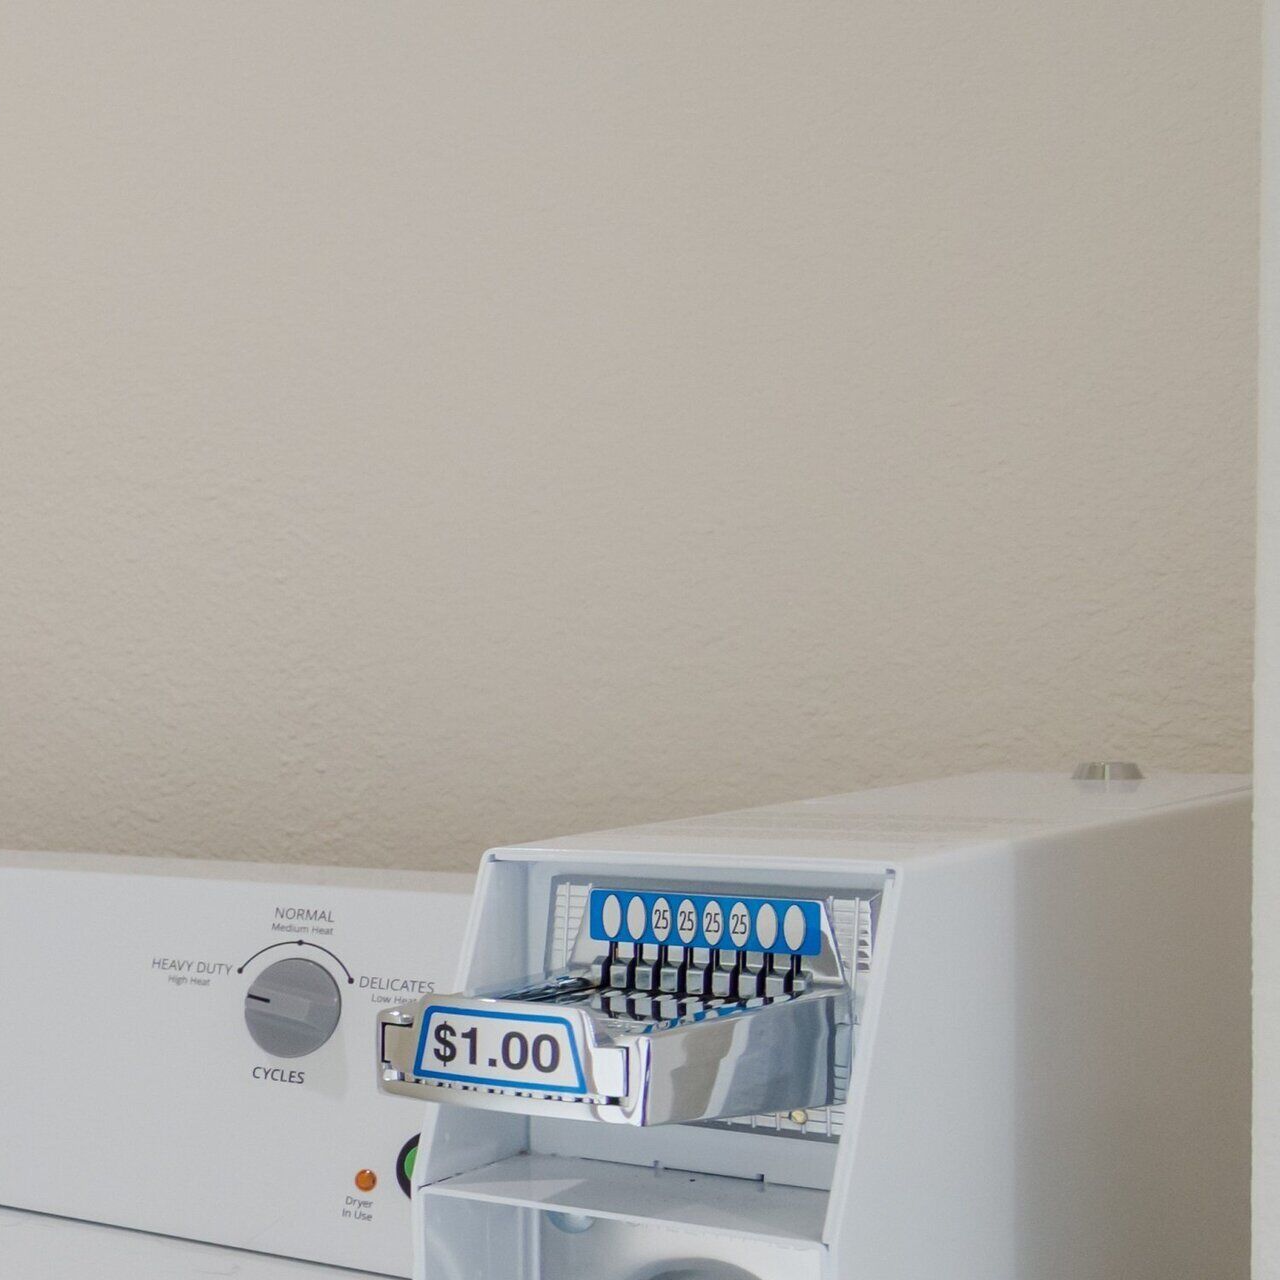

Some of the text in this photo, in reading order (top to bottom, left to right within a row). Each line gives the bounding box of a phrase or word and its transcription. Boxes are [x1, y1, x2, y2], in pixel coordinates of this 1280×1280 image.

[274, 907, 335, 923] NORMAL
[654, 909, 747, 935] 25 25 25 25
[271, 922, 334, 936] Medium Heat
[151, 957, 234, 976] HEAVY DUTY
[168, 975, 211, 987] High Heat
[359, 976, 436, 993] DELICATES
[371, 993, 392, 1003] Low
[433, 1021, 560, 1074] $1.00
[252, 1066, 305, 1084] CYCLES
[345, 1196, 374, 1209] Dryer
[342, 1208, 373, 1221] In Use
